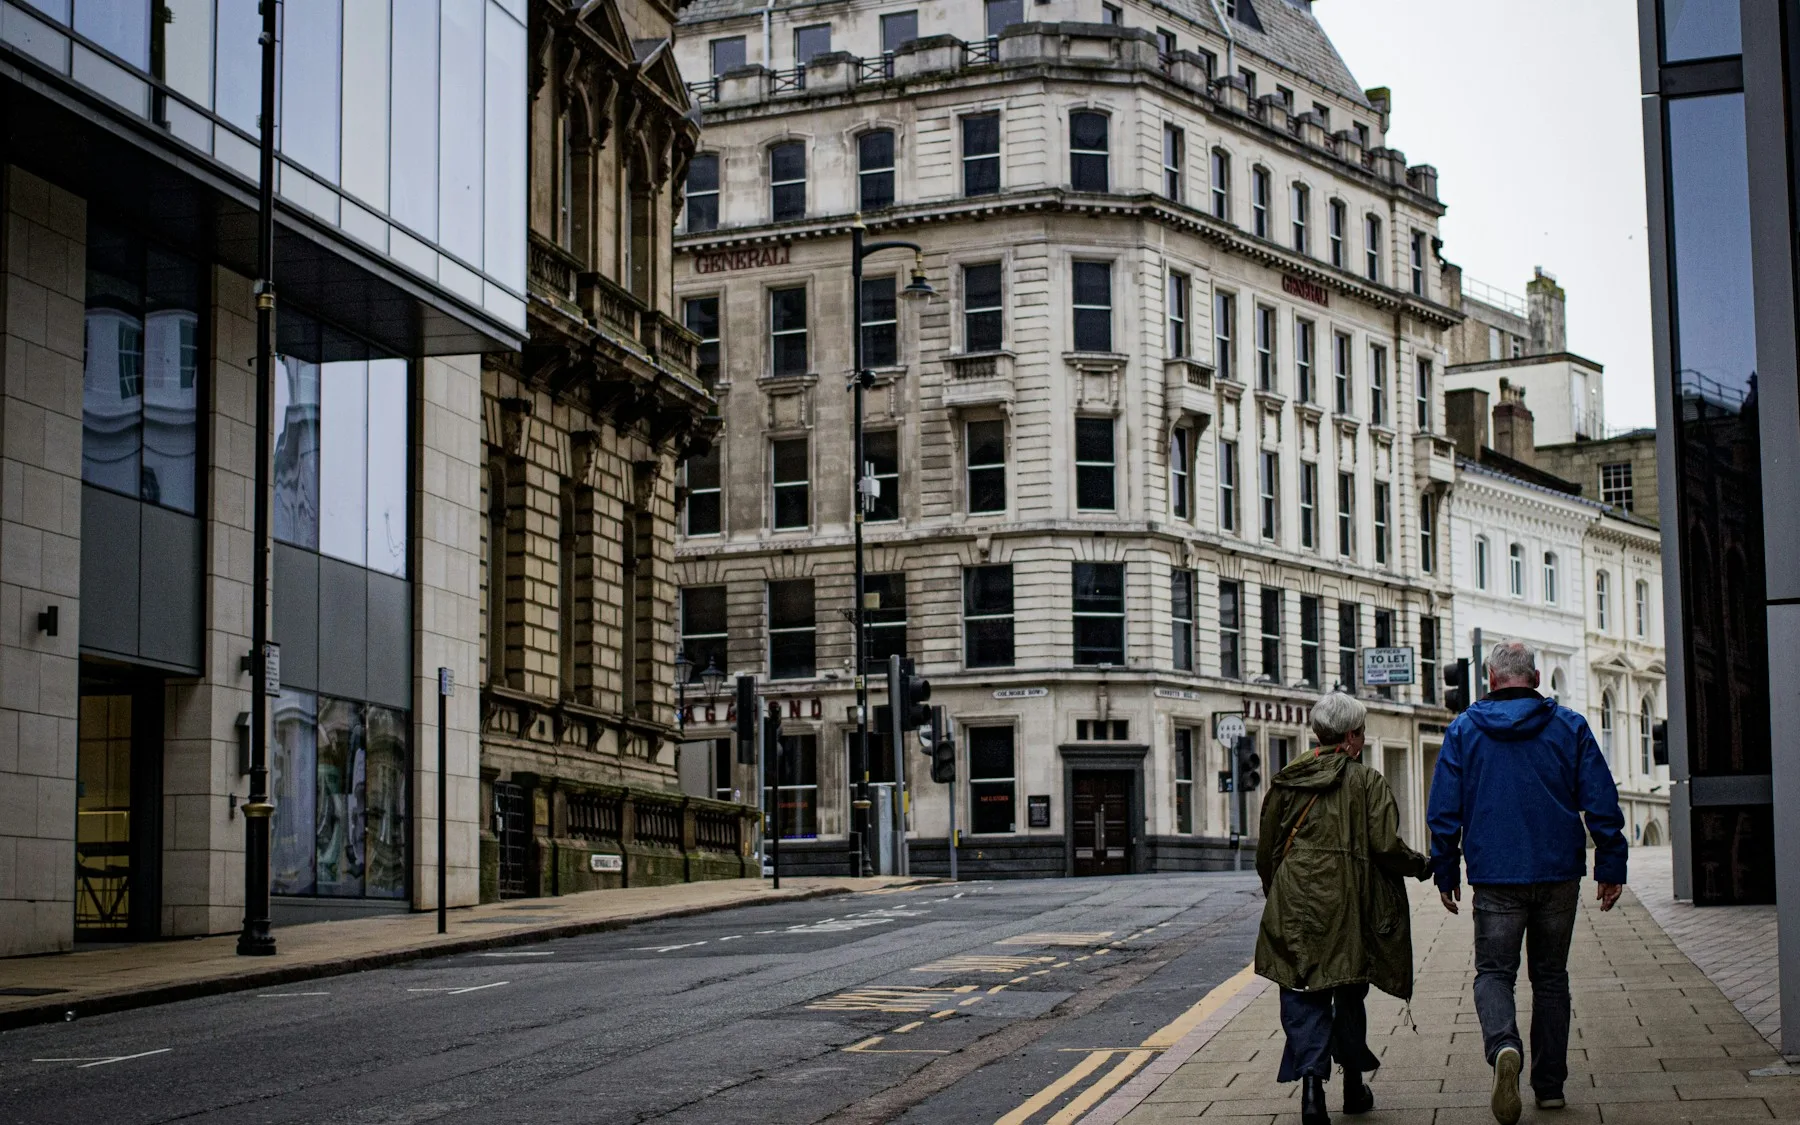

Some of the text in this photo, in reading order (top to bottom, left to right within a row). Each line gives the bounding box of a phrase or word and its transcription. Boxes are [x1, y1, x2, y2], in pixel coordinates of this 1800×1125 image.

[695, 246, 790, 274] GENERALI
[1370, 654, 1406, 663] TO LET
[1243, 700, 1312, 726] VAGABO
